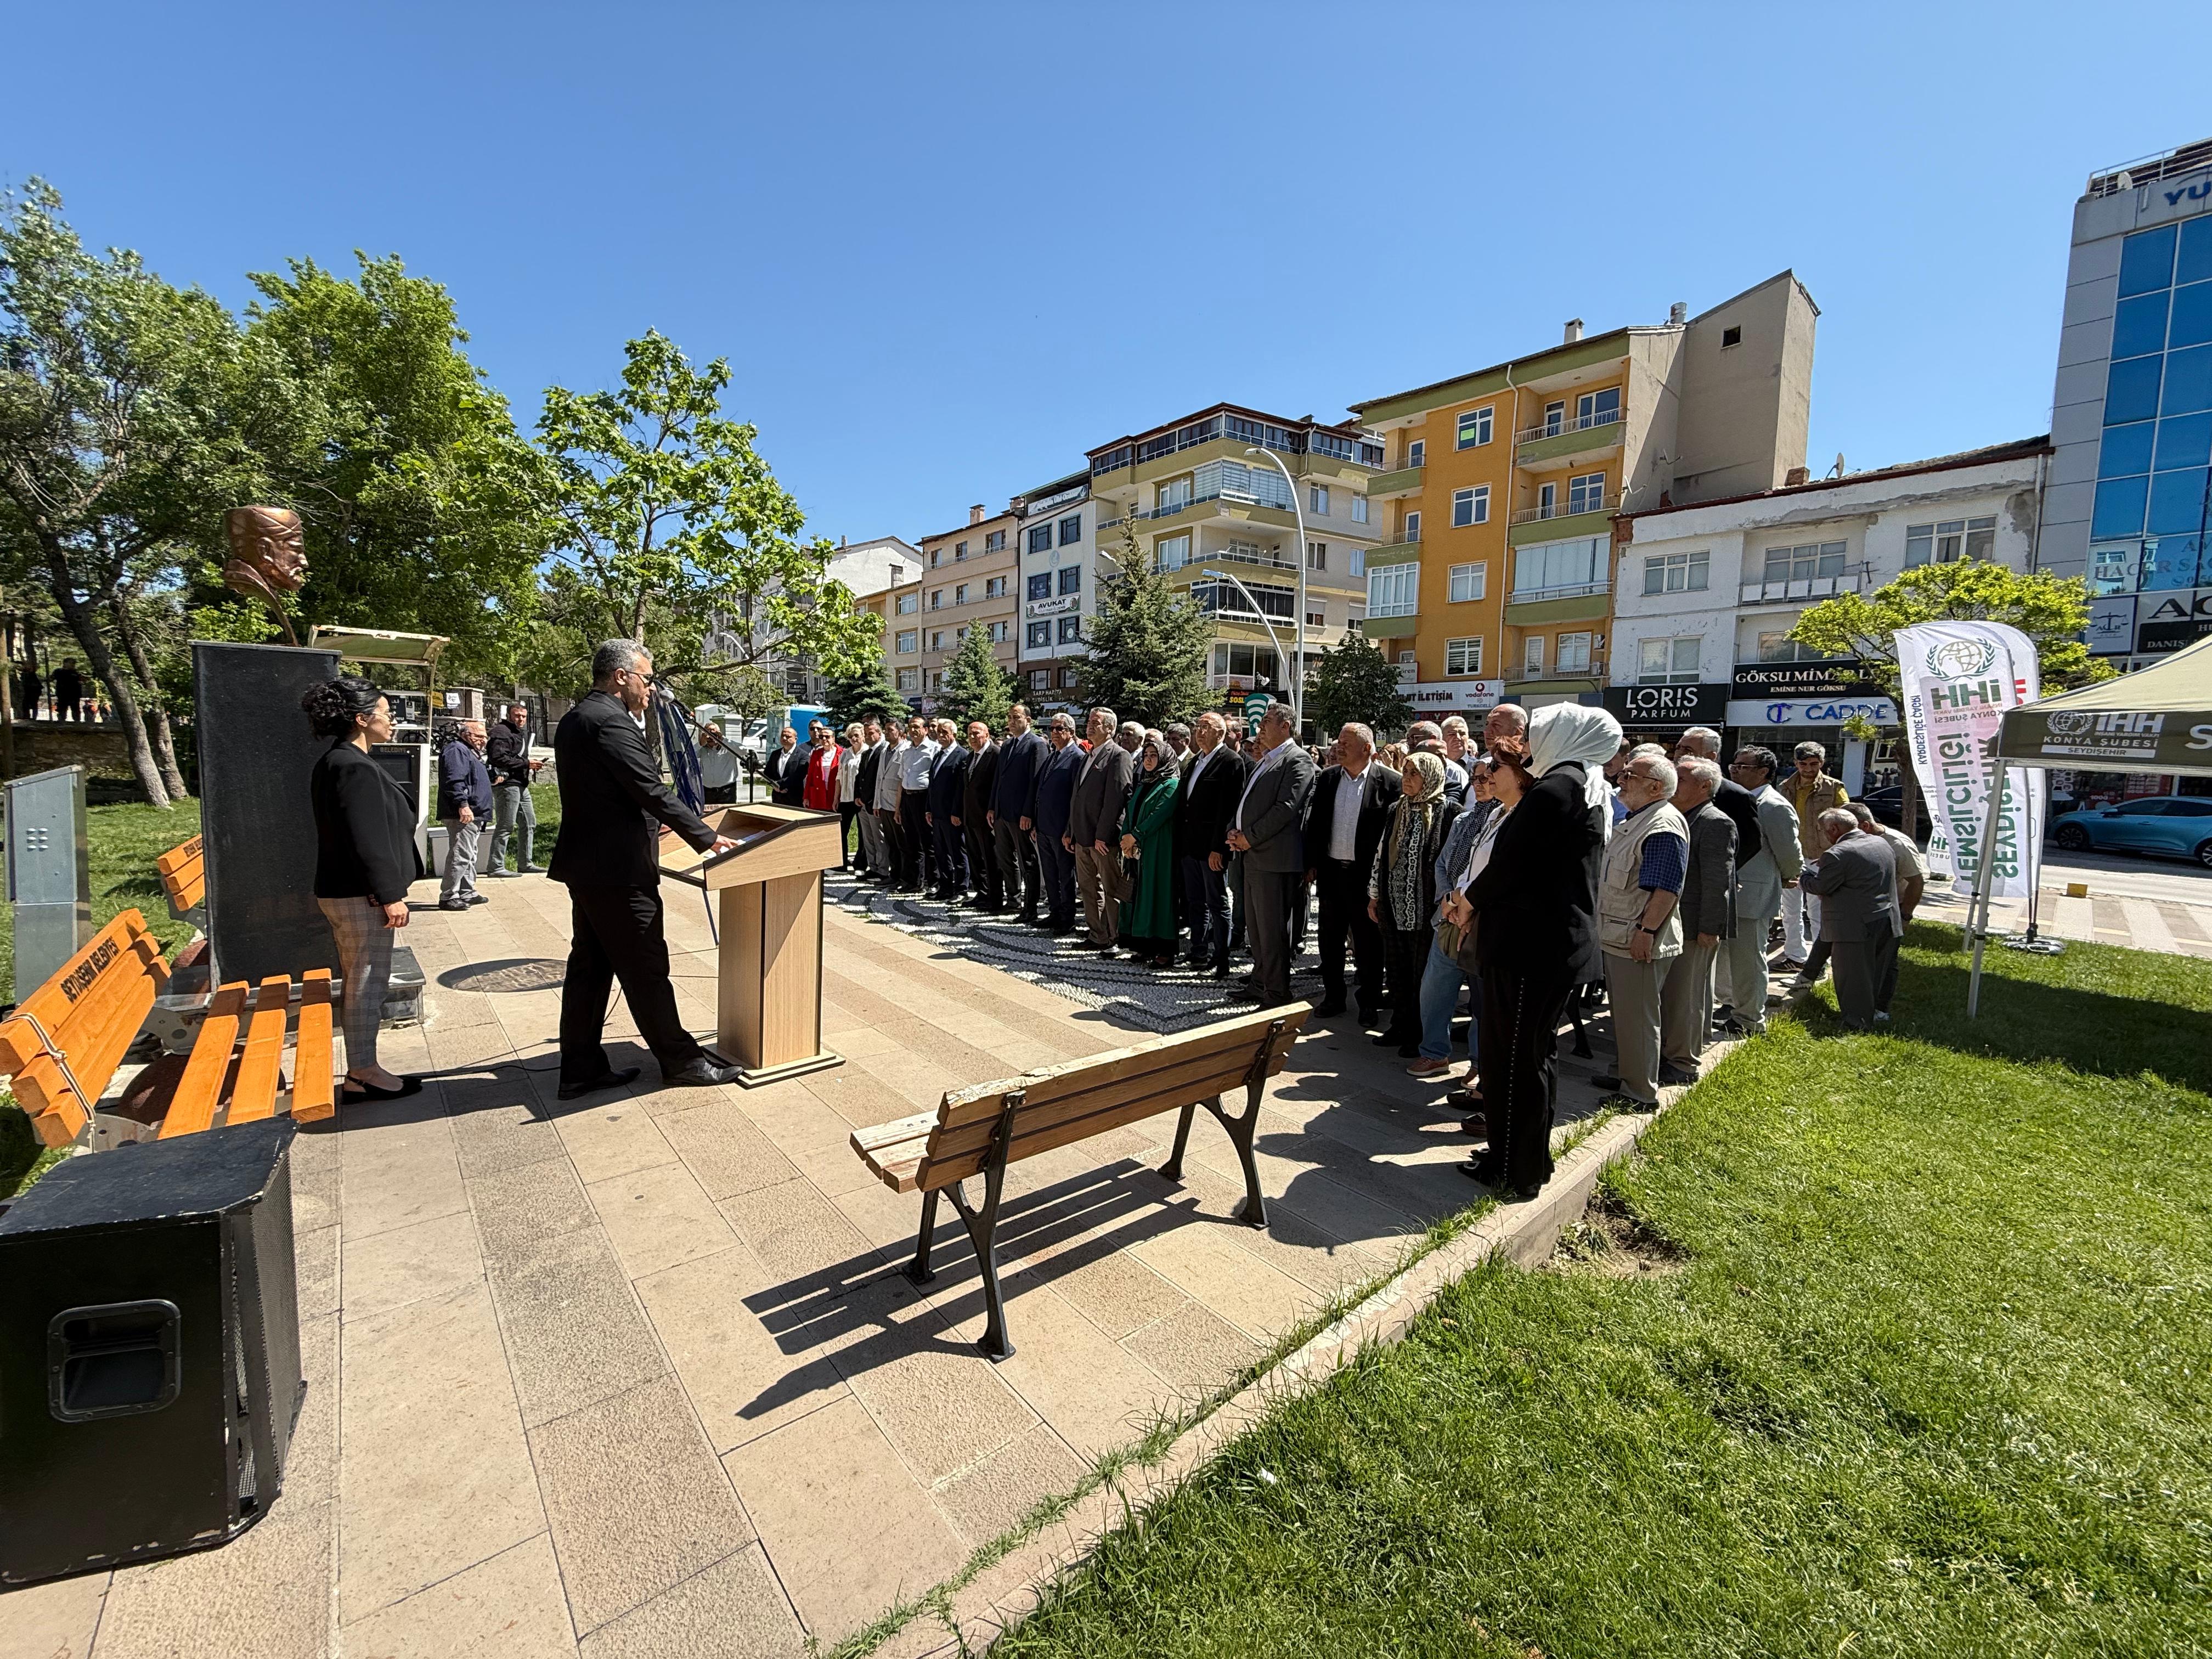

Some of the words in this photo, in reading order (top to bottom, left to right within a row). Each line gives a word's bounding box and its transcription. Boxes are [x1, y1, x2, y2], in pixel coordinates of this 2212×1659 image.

[1039, 599, 1066, 609] AVUKAT
[1736, 670, 1791, 683] GÖKSU
[1417, 690, 1453, 703] İLETİŞİM
[1626, 687, 1698, 708] LORIS
[1631, 709, 1691, 719] PARFUM
[2043, 736, 2092, 746] KONYA
[2100, 738, 2159, 748] ŞUBESİ
[2068, 747, 2127, 756] SEYDİŞEHİR
